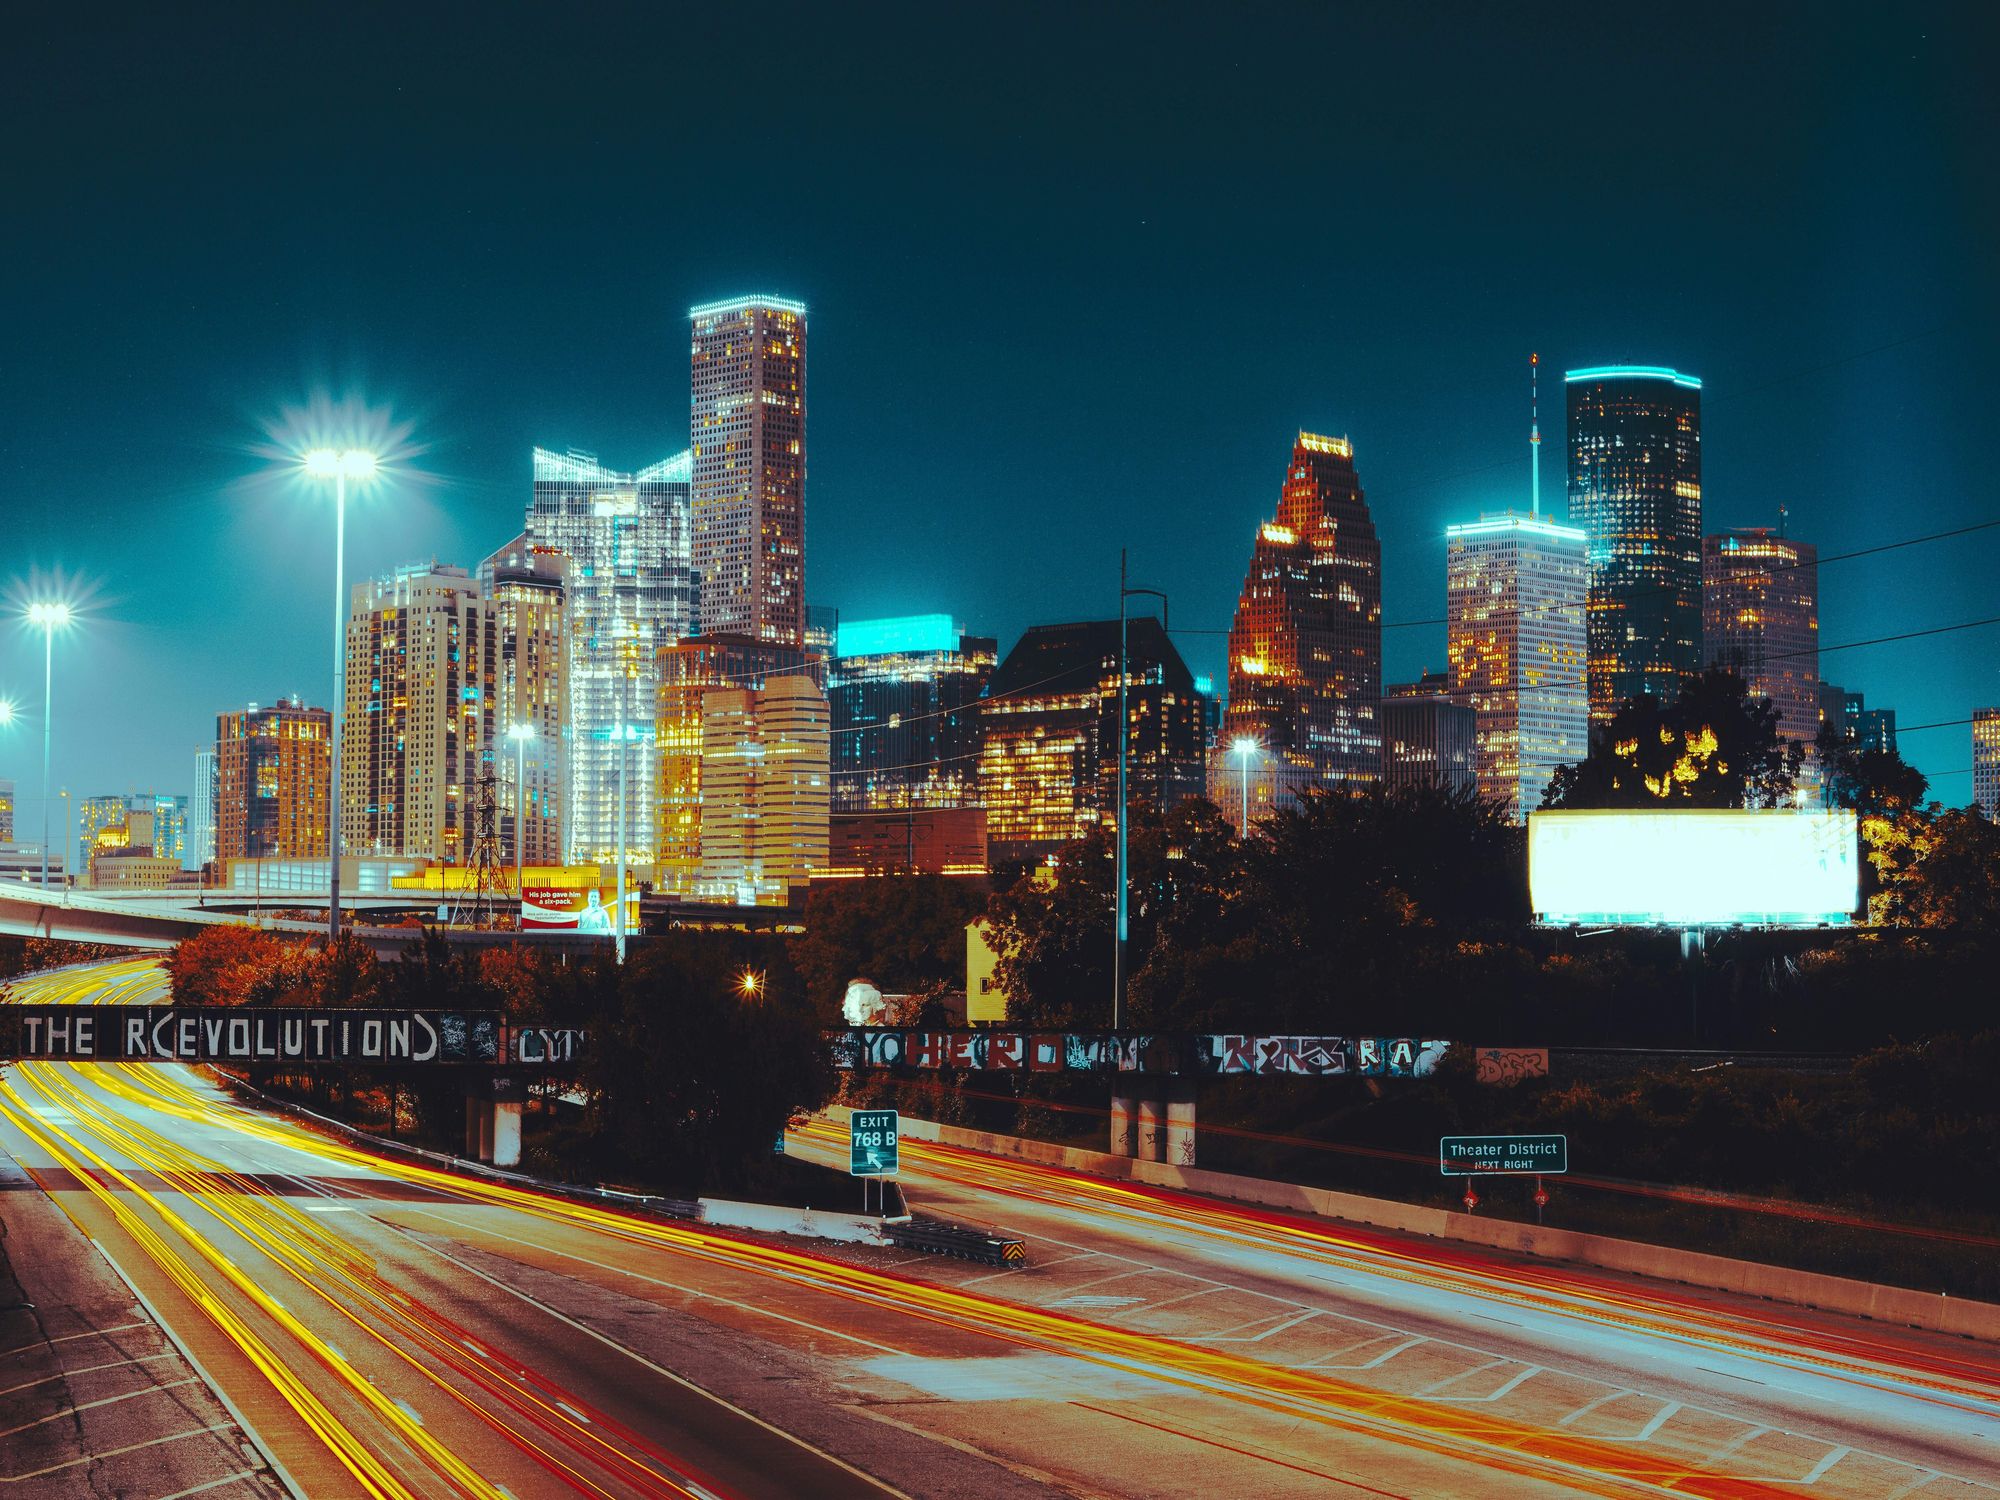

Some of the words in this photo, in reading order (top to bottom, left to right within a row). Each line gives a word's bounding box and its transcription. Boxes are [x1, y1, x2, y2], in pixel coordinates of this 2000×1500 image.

[540, 891, 551, 899] job
[24, 1016, 93, 1055] THE
[860, 1116, 889, 1128] EXIT
[853, 1131, 882, 1147] 768
[885, 1131, 896, 1146] B
[1450, 1144, 1502, 1156] Theater
[1509, 1143, 1557, 1155] District
[1474, 1160, 1499, 1170] NEXT
[1504, 1160, 1533, 1169] RIGHT
